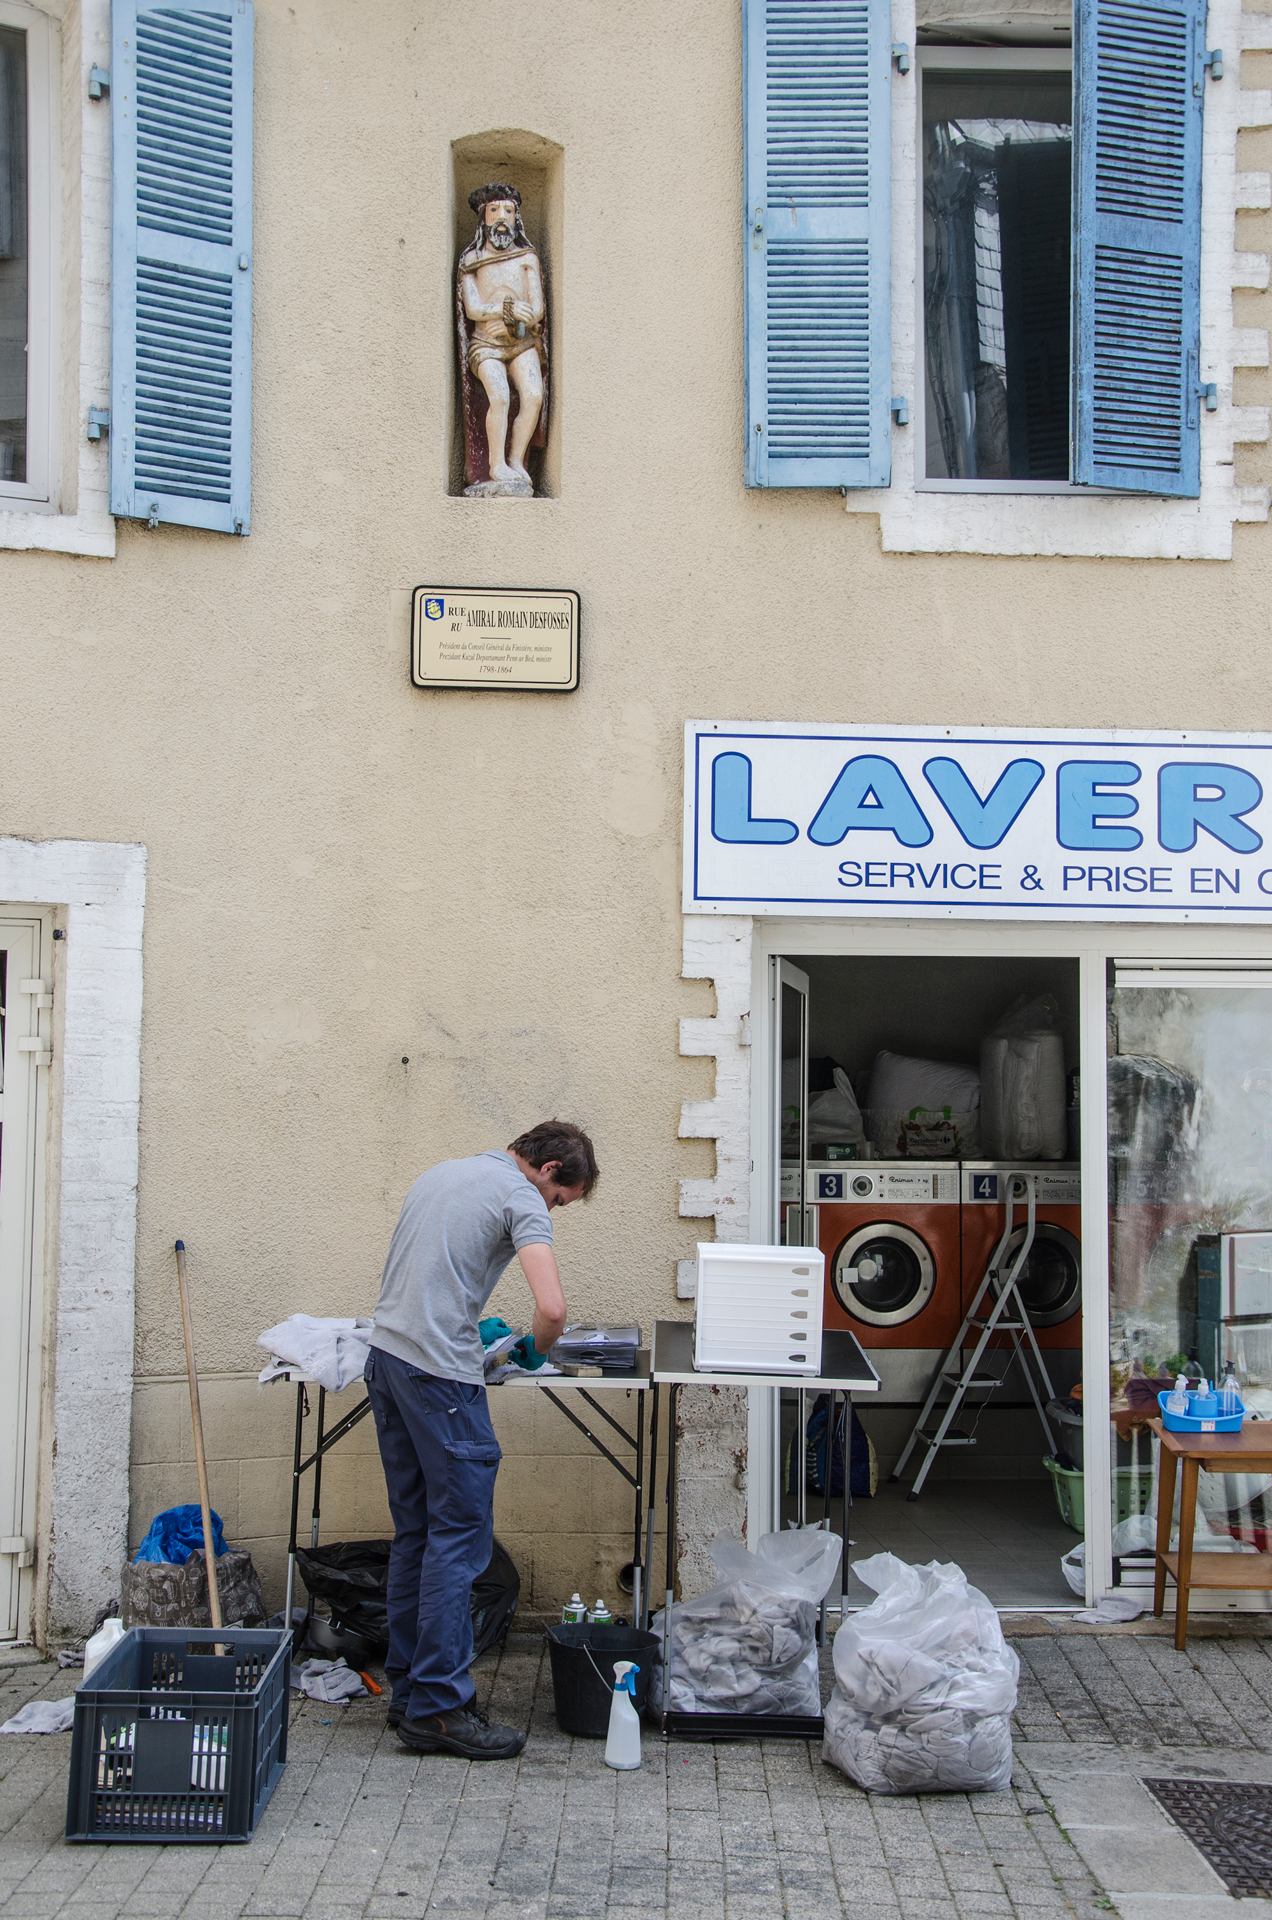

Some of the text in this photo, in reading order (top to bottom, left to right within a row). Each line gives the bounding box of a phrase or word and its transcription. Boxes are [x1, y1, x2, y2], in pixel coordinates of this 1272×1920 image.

[448, 607, 570, 630] RUE AMIRAL ROMAIN DESFOSSES
[450, 622, 462, 632] RU
[467, 642, 485, 651] Conseil
[479, 665, 513, 674] 1798-1864
[711, 750, 1264, 855] LAVER
[837, 861, 1003, 890] SERVICE
[1019, 864, 1045, 891] &
[1062, 865, 1173, 893] PRISE
[1190, 868, 1241, 894] EN
[825, 1175, 837, 1196] 3
[978, 1176, 991, 1197] 4
